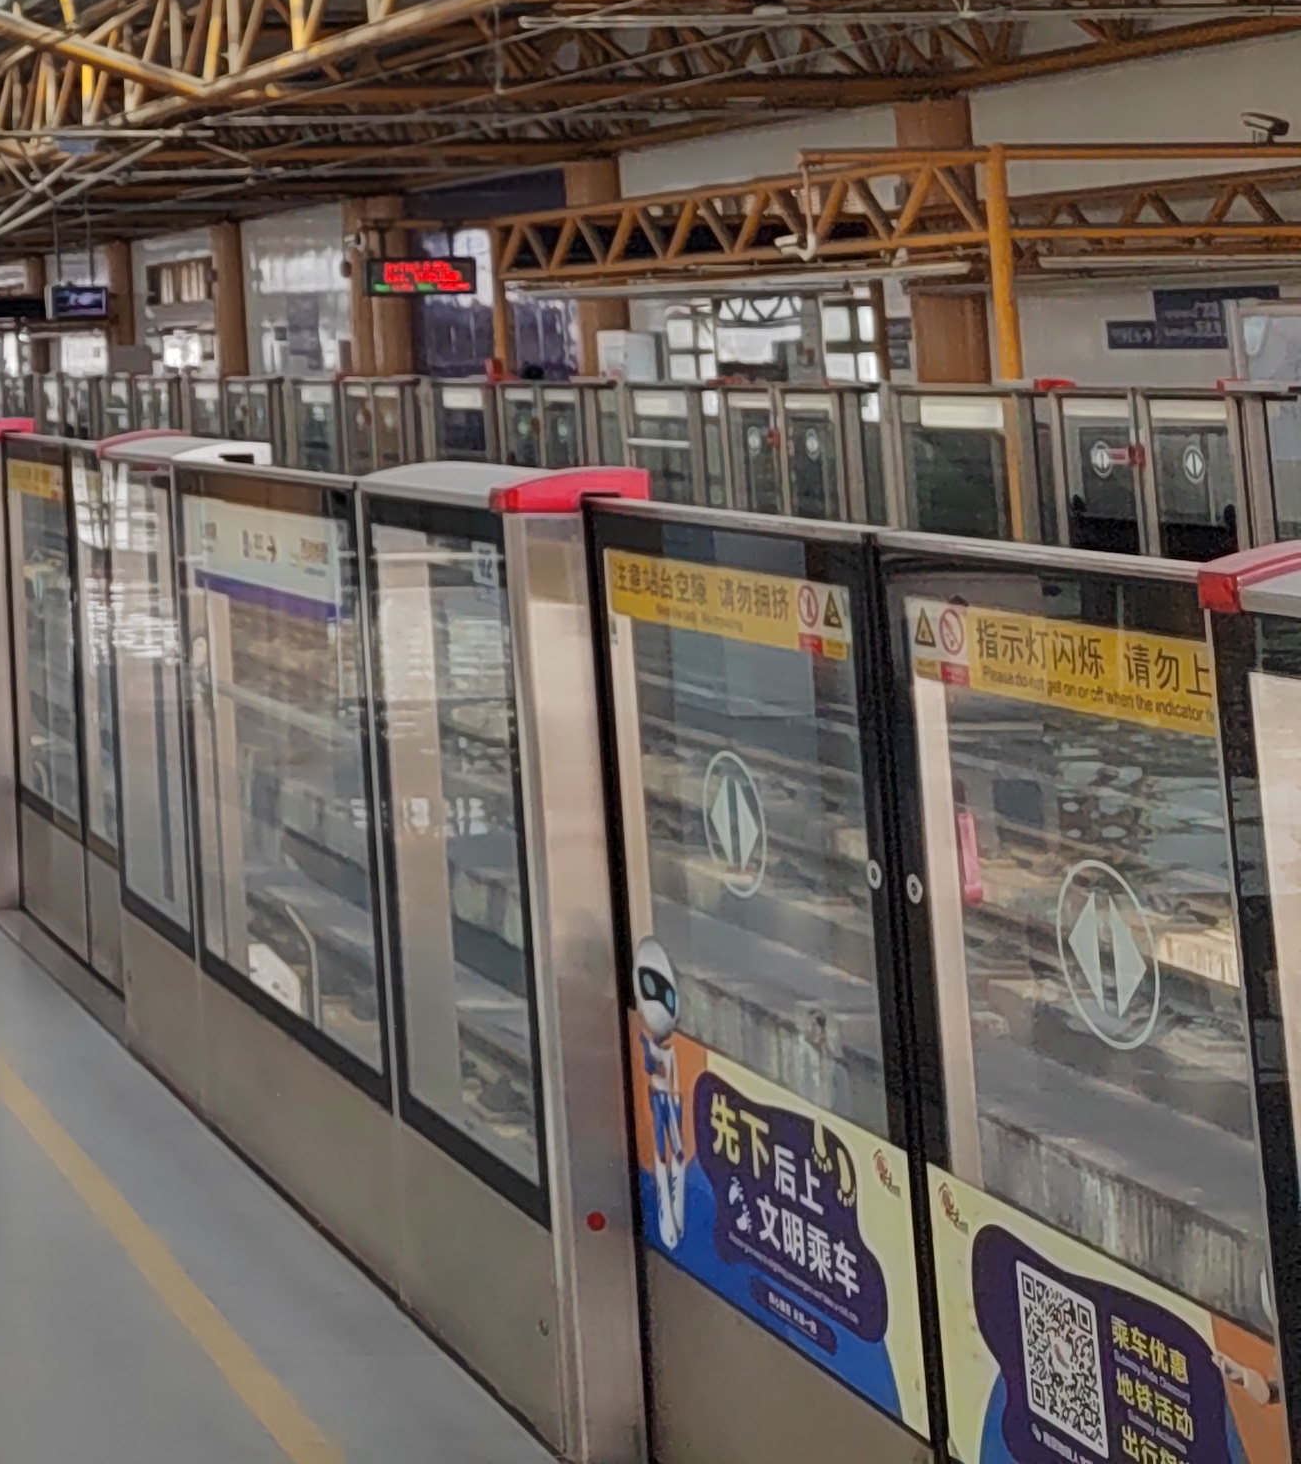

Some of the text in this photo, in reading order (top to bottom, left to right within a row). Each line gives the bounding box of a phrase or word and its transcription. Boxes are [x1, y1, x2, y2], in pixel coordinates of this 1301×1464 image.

[717, 577, 790, 621] 请勿拥挤
[976, 617, 1105, 680] 指示灯闪烁
[1124, 642, 1212, 698] 请勿上
[982, 664, 1014, 686] Please
[1015, 671, 1028, 688] do
[1047, 679, 1063, 698] get
[1064, 683, 1078, 697] on
[1079, 685, 1091, 699] or
[1105, 688, 1135, 709] when
[1135, 693, 1154, 713] the
[1155, 698, 1205, 722] indicator
[755, 1194, 861, 1300] 文明乘车
[1110, 1314, 1190, 1385] 乘车优惠
[1115, 1367, 1196, 1443] 地铁活动
